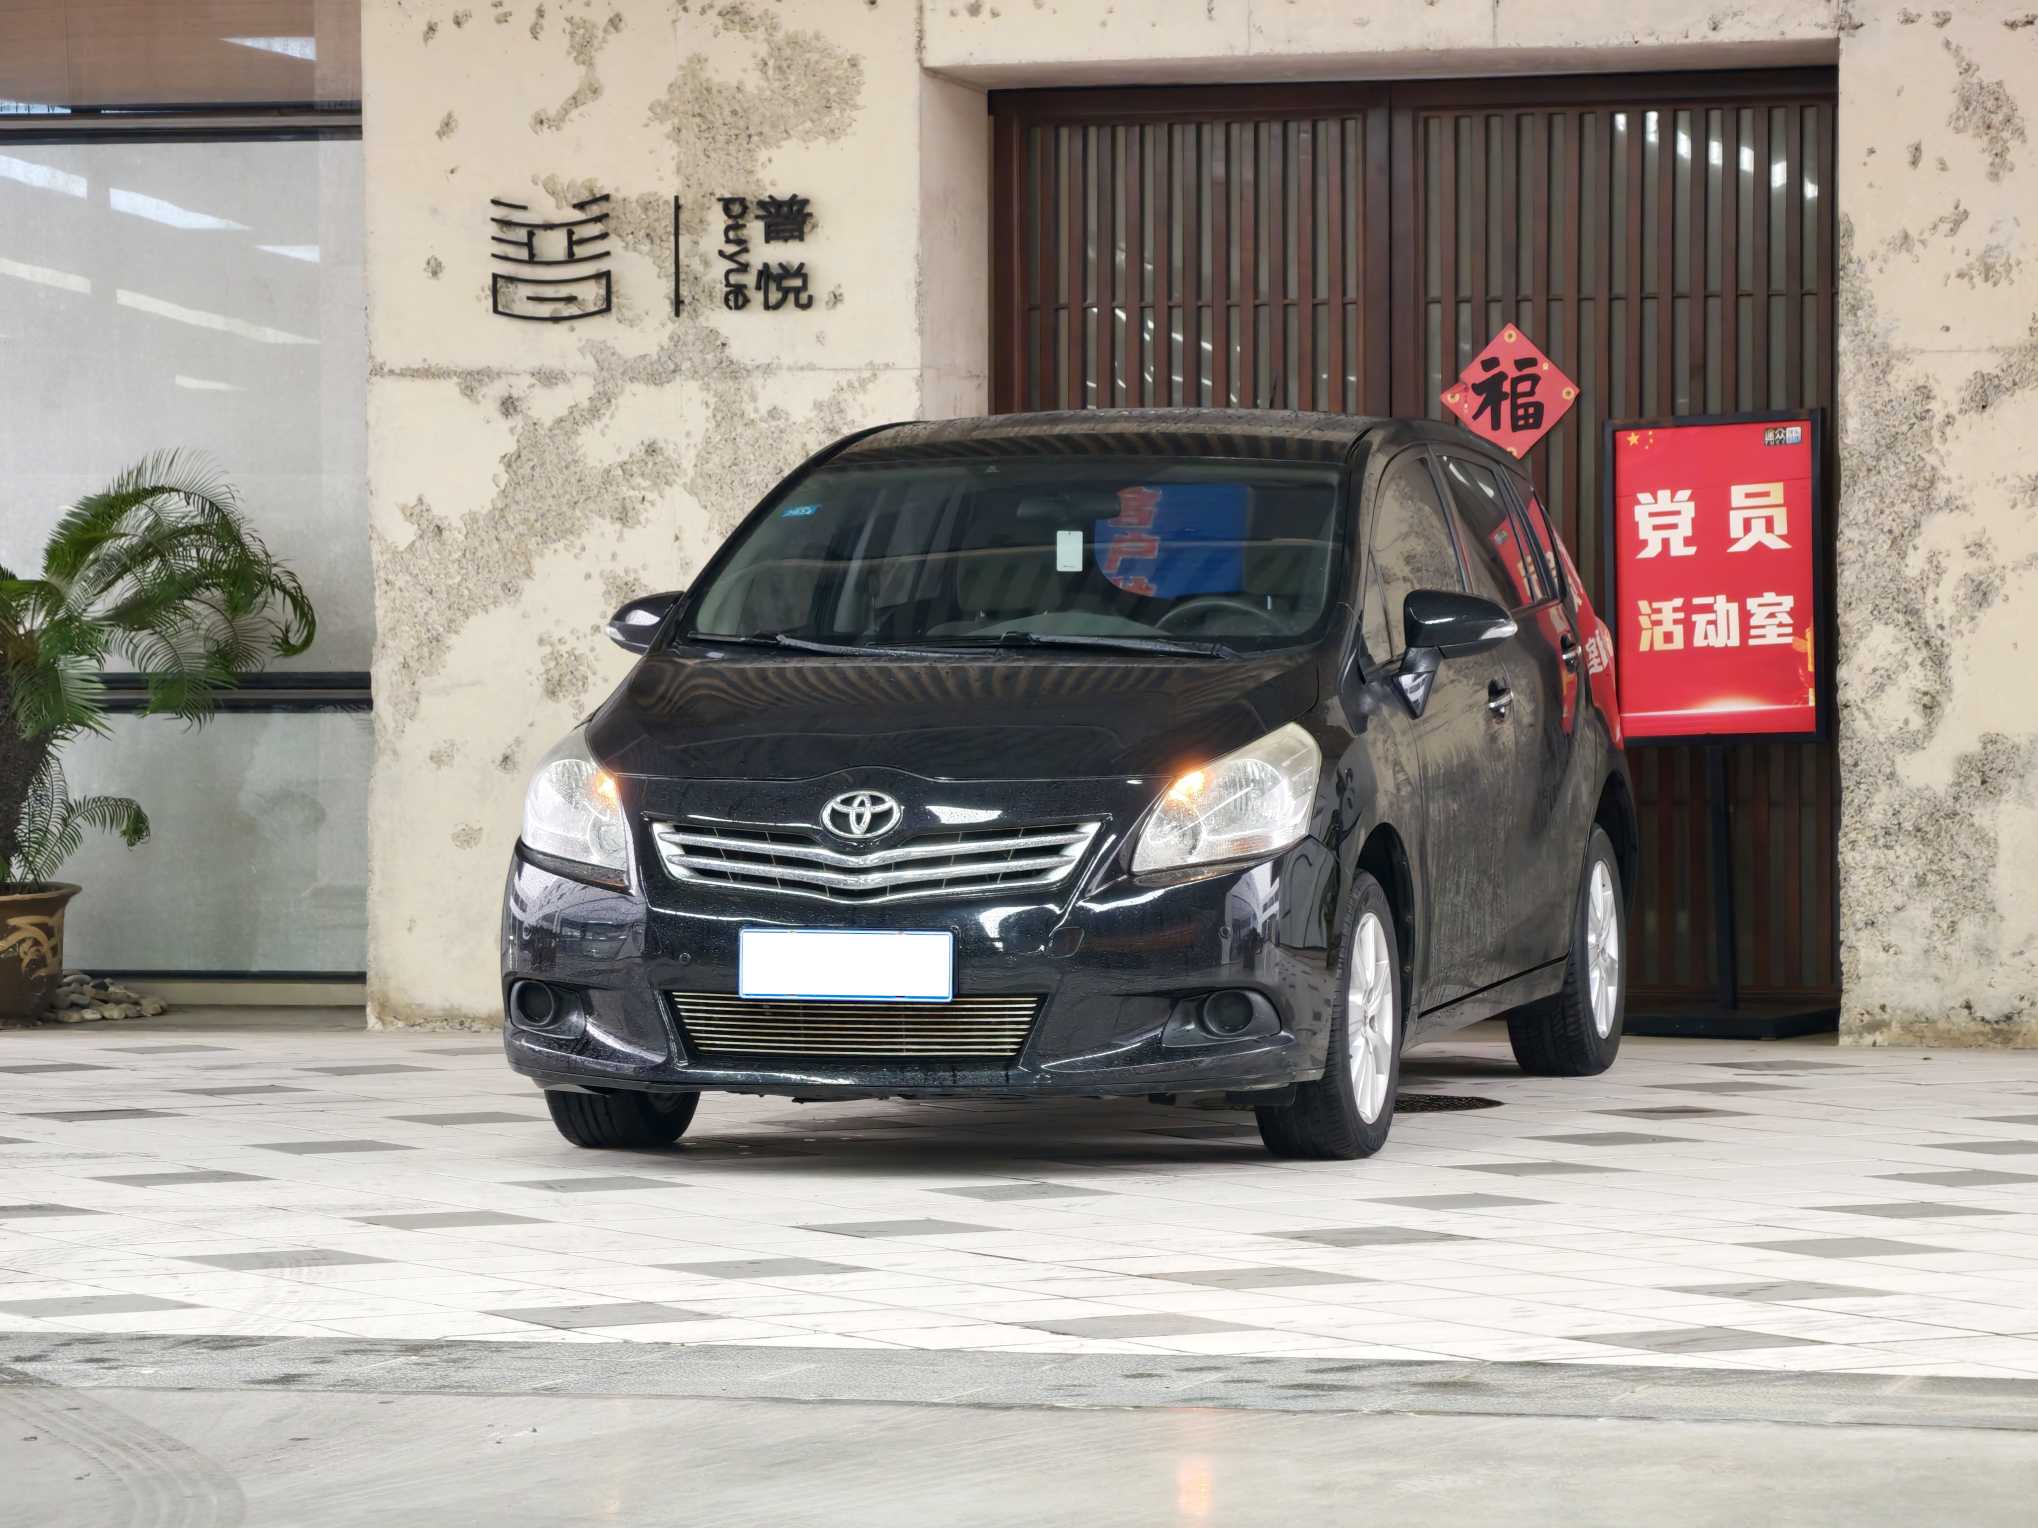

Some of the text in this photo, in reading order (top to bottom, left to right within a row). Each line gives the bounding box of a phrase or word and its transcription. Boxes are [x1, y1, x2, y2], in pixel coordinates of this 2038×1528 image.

[717, 196, 750, 310] puyue
[755, 193, 813, 311] 普悦
[1471, 356, 1545, 433] 福
[1633, 482, 1792, 559] 党员
[1637, 592, 1795, 652] 活动室
